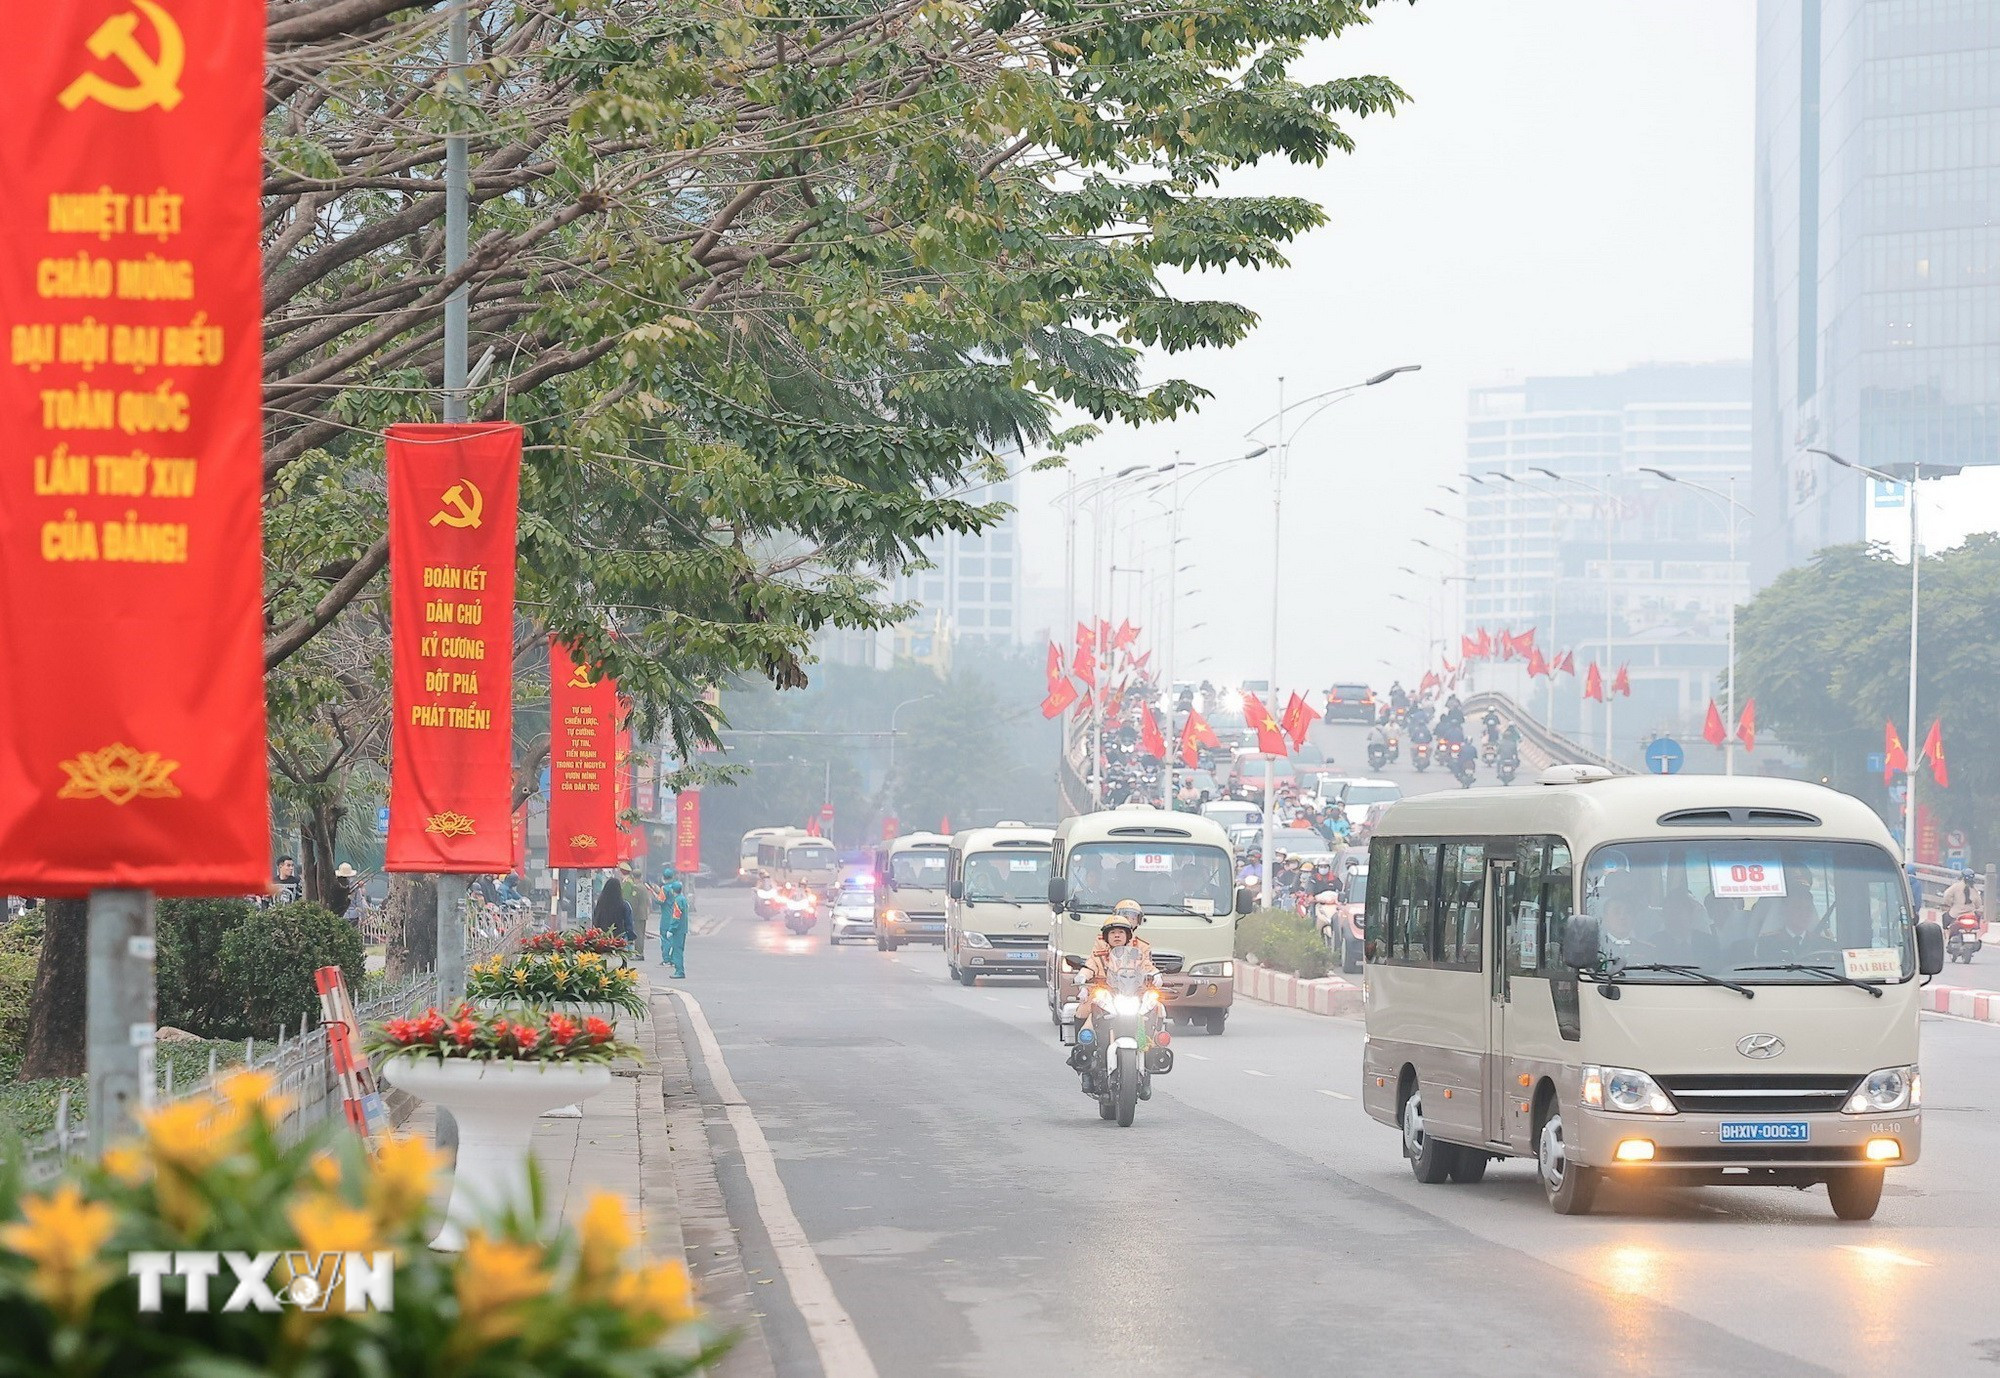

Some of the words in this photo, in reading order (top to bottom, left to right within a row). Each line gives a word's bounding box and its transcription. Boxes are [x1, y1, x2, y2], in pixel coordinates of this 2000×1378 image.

[133, 186, 184, 243] LIỆT
[37, 249, 113, 299] CHÀO
[117, 251, 194, 300] MỪNG
[11, 324, 55, 373] ĐẠI
[59, 315, 109, 373] HỘI
[112, 324, 160, 375] ĐẠI
[162, 310, 224, 367] BIỂU
[40, 380, 115, 430] TOÀN
[118, 378, 190, 436] QUỐC
[93, 449, 150, 497] THỨ
[150, 458, 198, 498] XIV
[41, 507, 99, 562] CỦA
[102, 508, 188, 563] ĐẢNG!
[423, 564, 460, 588] ĐOÀN
[463, 564, 487, 590] KẾT
[426, 599, 453, 623] DÂN
[457, 599, 482, 625] CHỦ
[421, 631, 439, 657] KỶ
[441, 637, 485, 660] CƯƠNG
[425, 668, 450, 696] ĐỘT
[453, 670, 478, 694] PHÁ
[411, 702, 445, 727] PHÁT
[448, 701, 490, 730] TRIỂN!
[564, 715, 582, 725] CHIẾN
[572, 706, 580, 715] TỰ
[580, 705, 592, 714] CHỦ
[567, 728, 575, 737] TỰ
[572, 739, 580, 748] TỰ
[565, 749, 579, 758] TIẾN
[579, 750, 597, 759] MẠNH
[561, 781, 573, 791] CỦA
[573, 782, 586, 791] DÂN
[1145, 854, 1162, 864] 09
[1731, 865, 1765, 882] 08
[1850, 963, 1869, 974] ĐẠI
[1871, 960, 1896, 972] BIỂU
